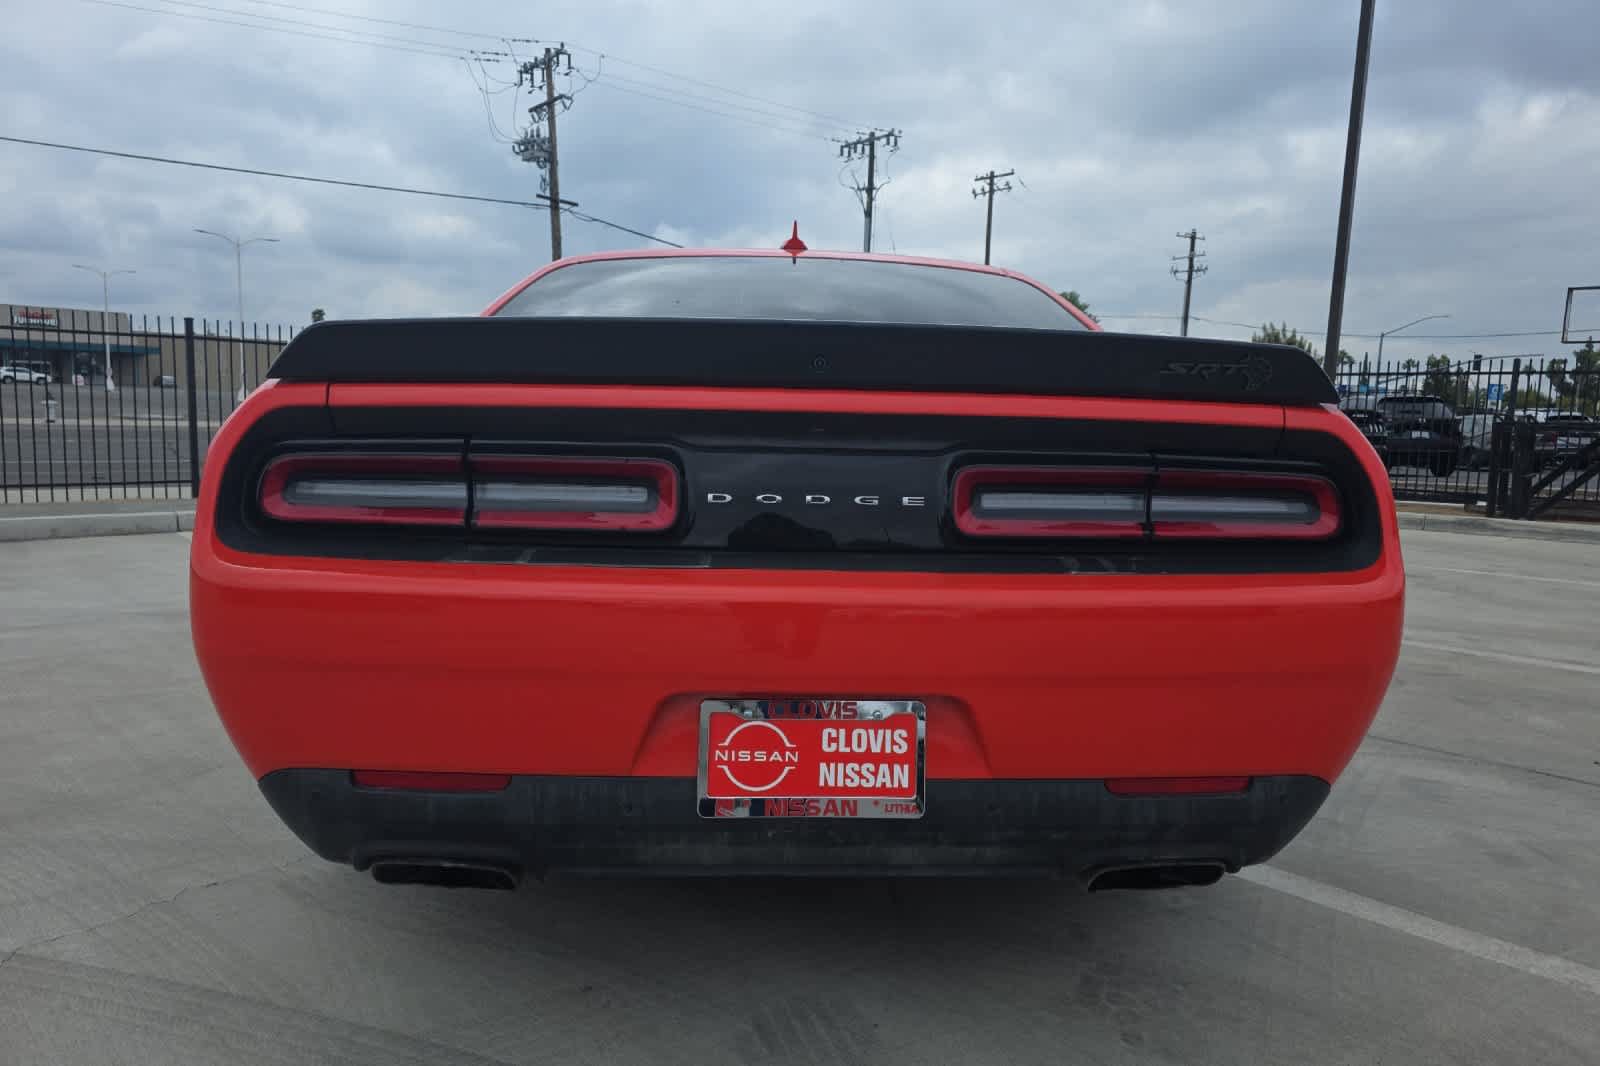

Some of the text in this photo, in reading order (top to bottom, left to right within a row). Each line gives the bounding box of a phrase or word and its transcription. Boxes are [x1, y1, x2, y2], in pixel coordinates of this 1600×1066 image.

[1160, 362, 1246, 380] SRT
[707, 493, 925, 506] DODGE
[767, 701, 858, 719] CLOVIS
[821, 728, 908, 754] CLOVIS
[715, 750, 799, 763] NISSAN
[819, 763, 909, 788] NISSAN
[765, 799, 858, 816] NISSAN
